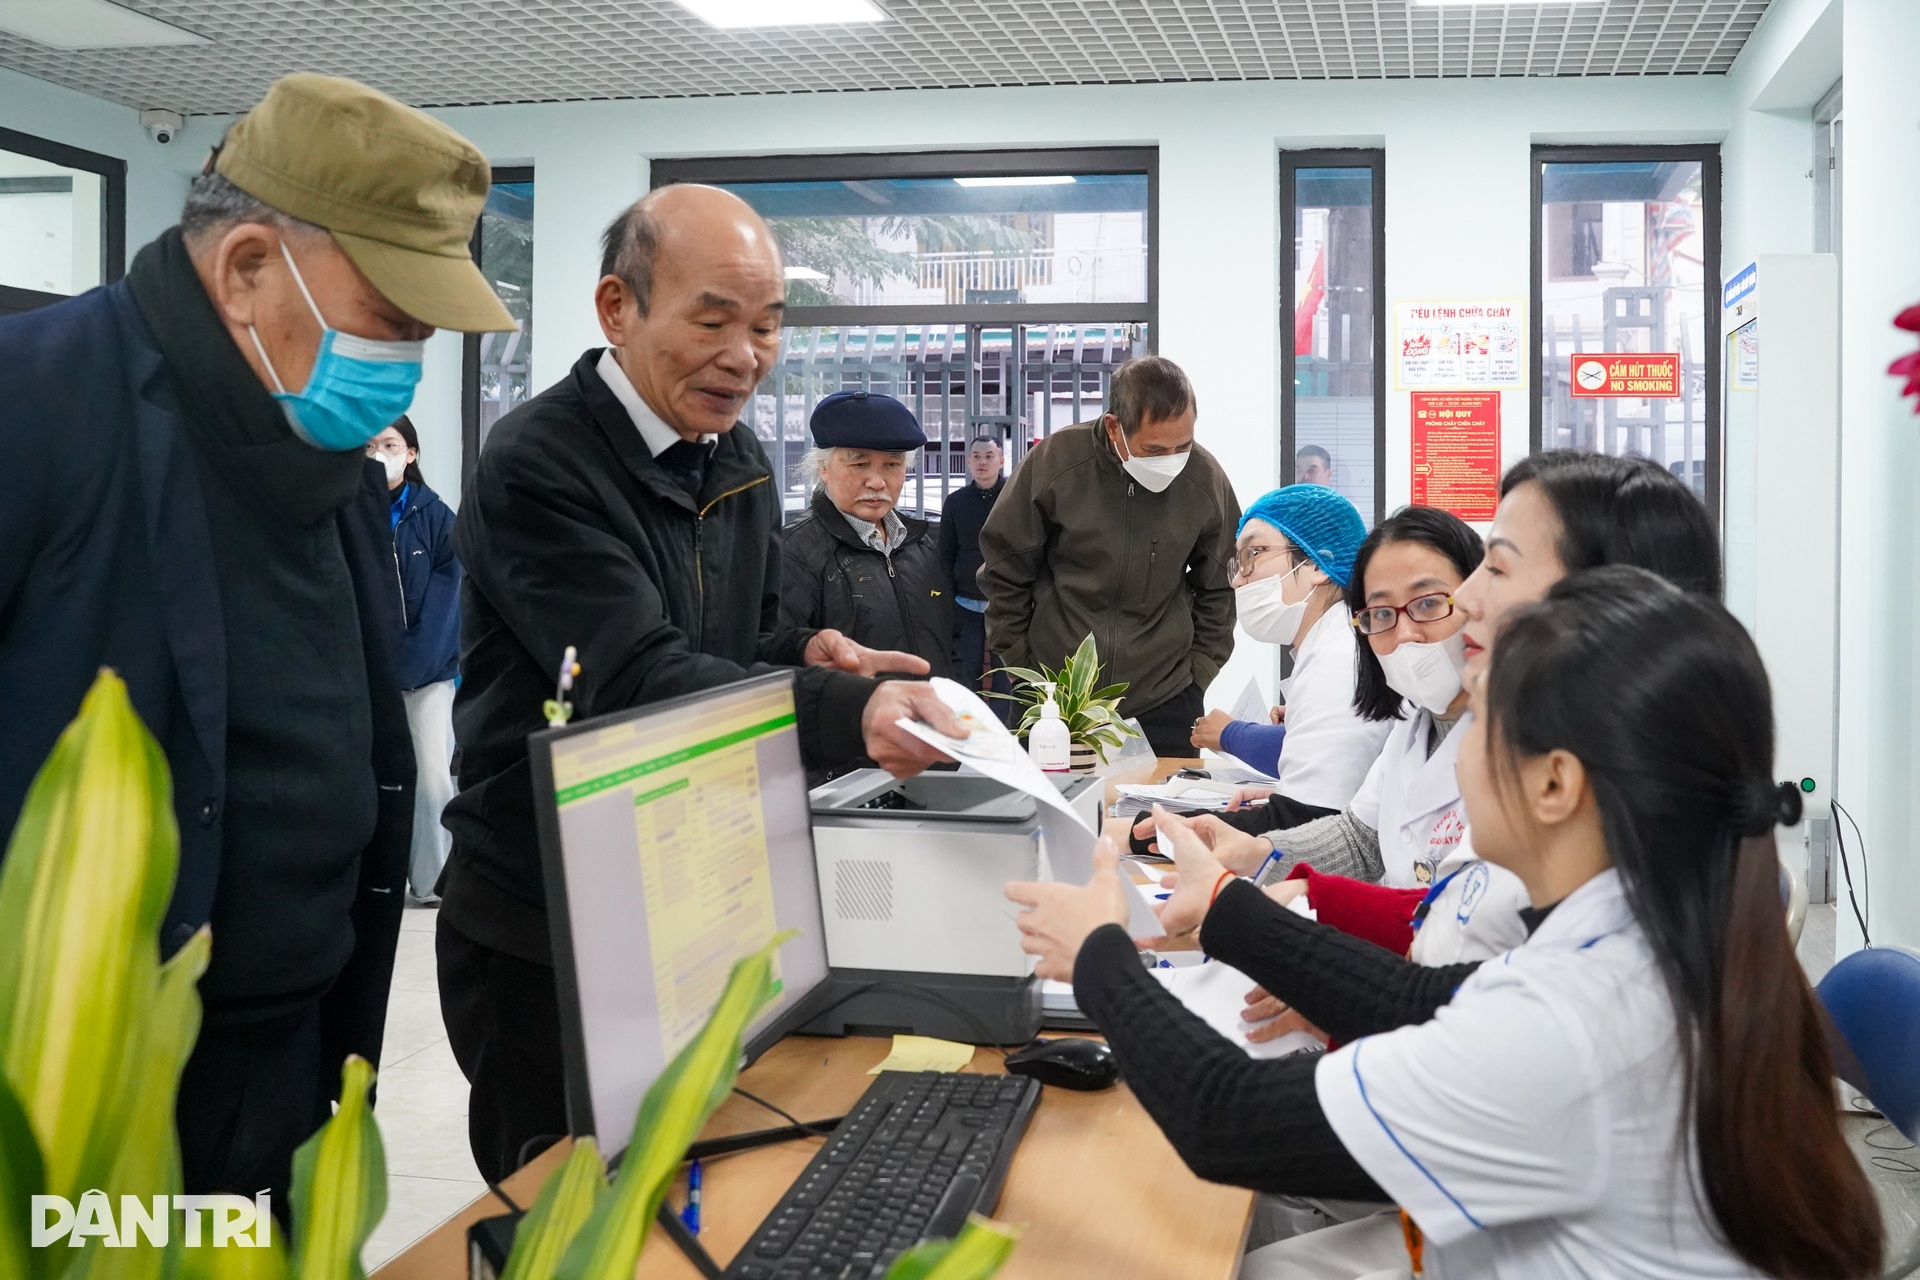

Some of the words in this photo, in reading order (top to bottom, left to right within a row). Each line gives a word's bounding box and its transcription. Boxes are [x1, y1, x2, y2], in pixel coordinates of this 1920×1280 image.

[1432, 307, 1456, 320] LỆNH
[1459, 306, 1484, 318] CHỮA
[1486, 306, 1511, 318] CHÁY
[1610, 360, 1627, 377] CẤM
[1629, 361, 1645, 377] HÚT
[1647, 360, 1673, 377] THUỐC
[1610, 381, 1624, 391] NO
[1627, 381, 1673, 391] SMOKING
[1439, 410, 1453, 418] NỘI
